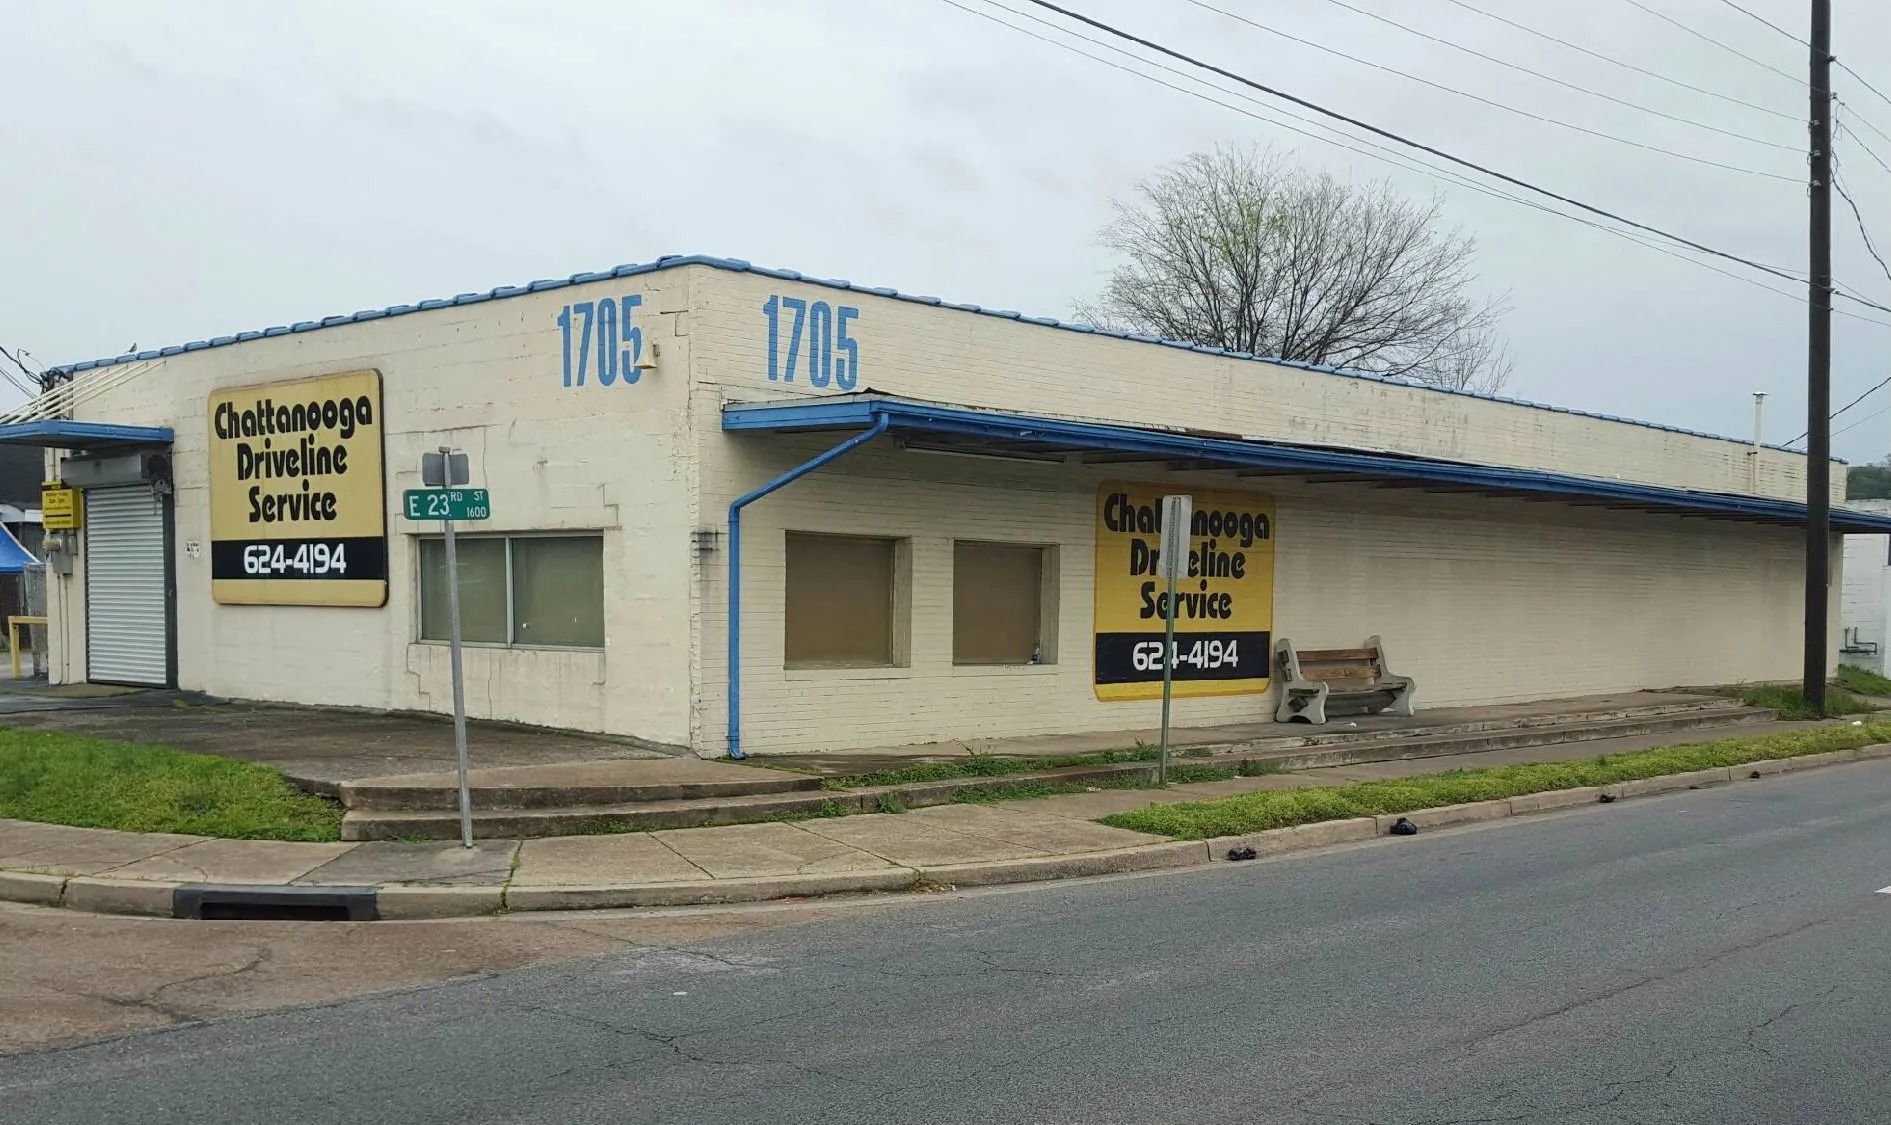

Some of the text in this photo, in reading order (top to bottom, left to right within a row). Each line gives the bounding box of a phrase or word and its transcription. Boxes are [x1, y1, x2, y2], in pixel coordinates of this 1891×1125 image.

[557, 294, 643, 387] 1705
[762, 294, 859, 391] 1705
[214, 395, 373, 440] Chattanooga
[236, 433, 348, 480] Driveline
[248, 479, 338, 523] Service
[408, 495, 421, 517] E
[474, 491, 484, 501] ST
[466, 506, 487, 518] 1600
[1104, 493, 1270, 548] Chatnooga
[243, 542, 347, 574] 624-4194
[1130, 538, 1246, 579] Dreline
[1139, 579, 1233, 620] Service
[1132, 639, 1239, 671] 624-4194
